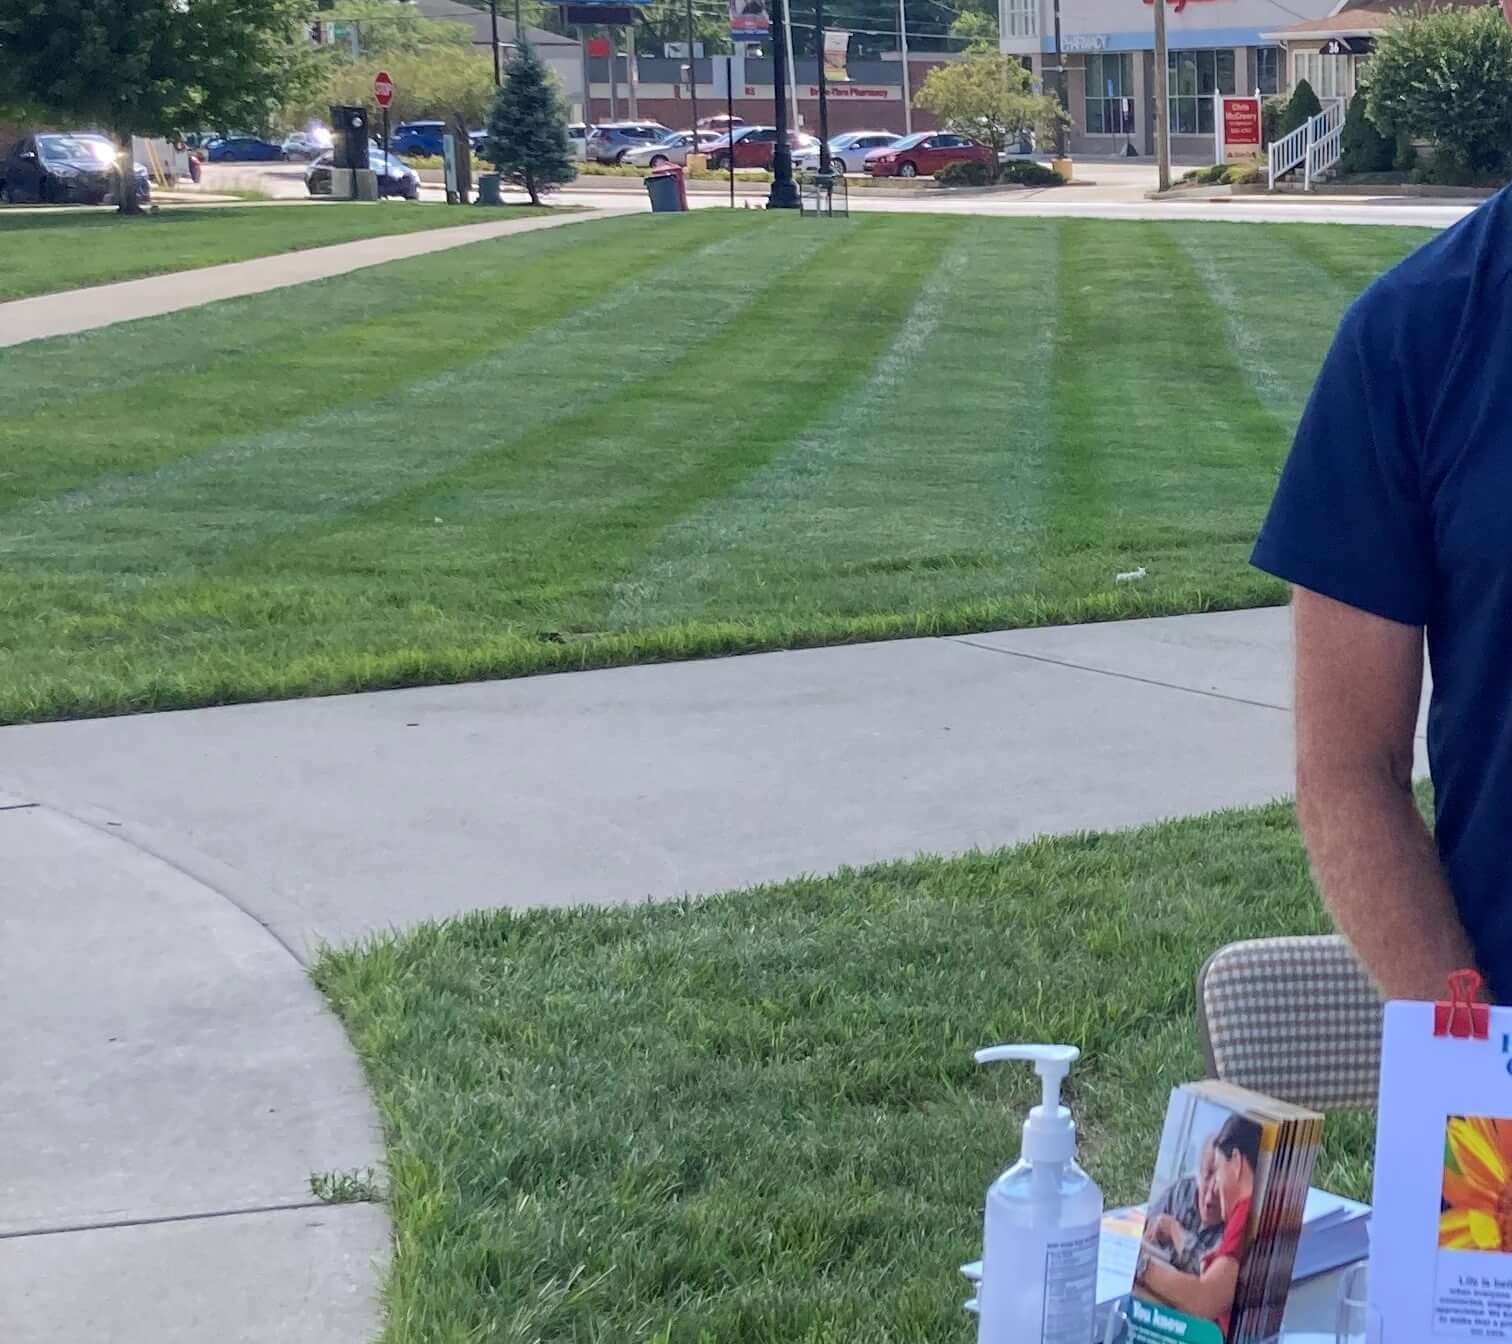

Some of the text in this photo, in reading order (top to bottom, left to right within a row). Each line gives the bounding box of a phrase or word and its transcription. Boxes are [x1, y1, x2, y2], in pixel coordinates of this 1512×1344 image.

[1328, 41, 1340, 54] 36
[850, 87, 889, 99] Pharmacy
[1133, 1300, 1151, 1323] You
